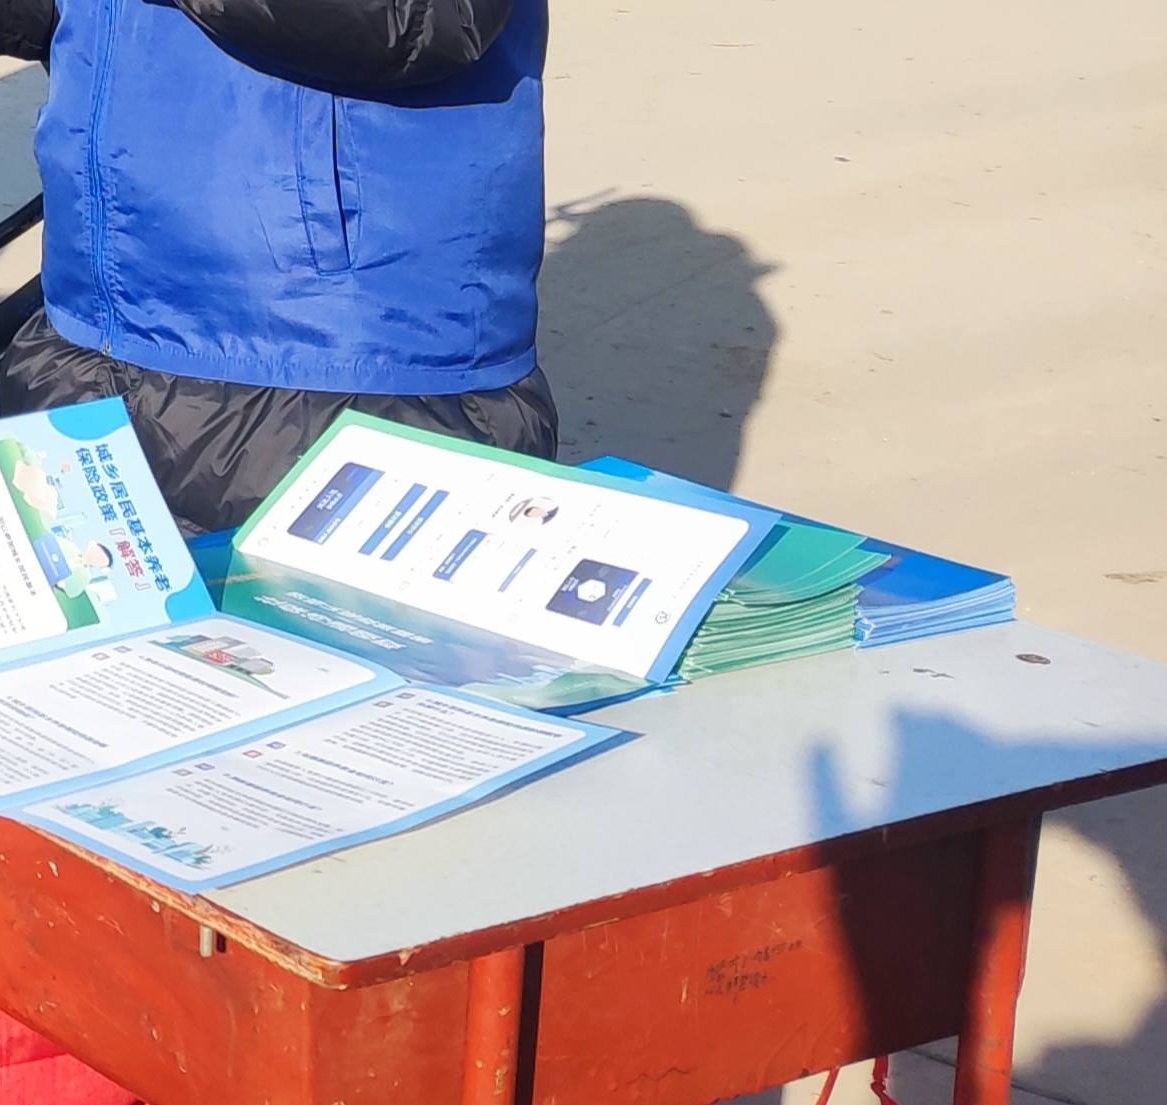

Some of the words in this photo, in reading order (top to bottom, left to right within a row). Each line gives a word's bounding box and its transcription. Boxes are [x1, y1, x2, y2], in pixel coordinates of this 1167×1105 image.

[95, 443, 172, 593] 城乡居民基本养老
